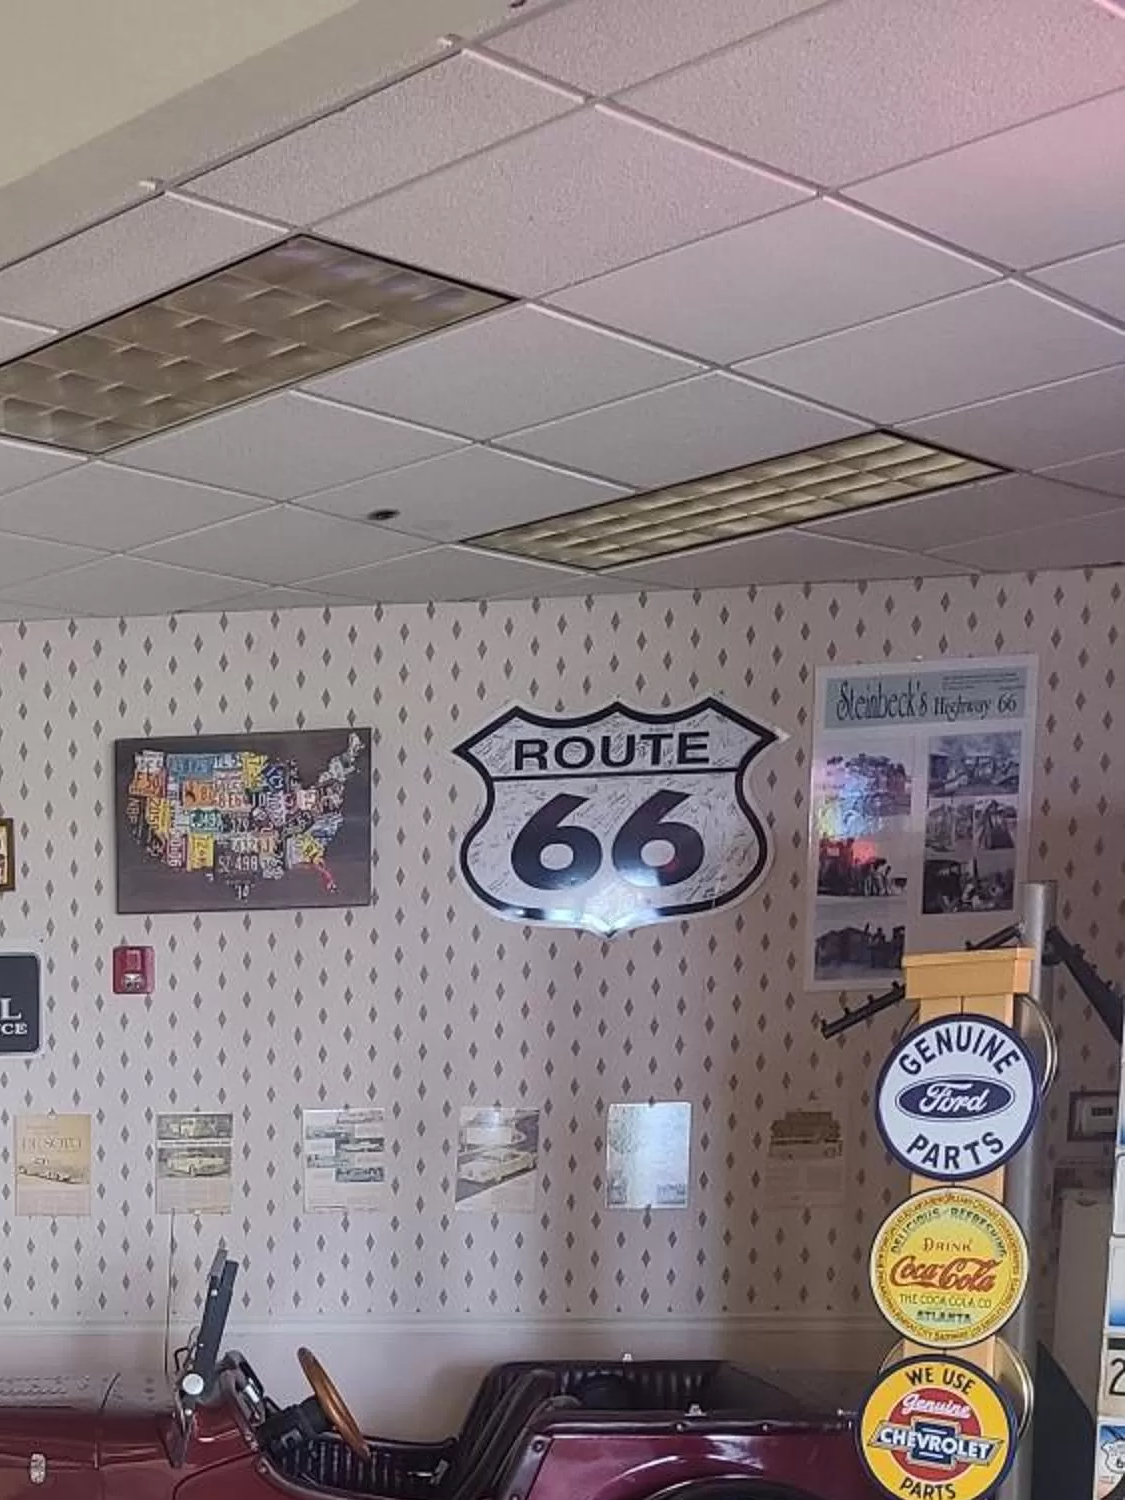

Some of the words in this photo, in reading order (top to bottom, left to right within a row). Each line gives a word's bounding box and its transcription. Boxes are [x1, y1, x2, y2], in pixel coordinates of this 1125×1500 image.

[997, 691, 1018, 713] 66
[514, 731, 710, 771] ROUTE
[510, 789, 705, 890] 66
[899, 1025, 1022, 1075] GENUINE
[918, 1080, 991, 1113] Ford
[906, 1130, 1005, 1170] PARTS
[923, 1237, 972, 1252] DRINK
[899, 1293, 918, 1305] THE
[905, 1367, 935, 1386] WE
[942, 1368, 976, 1395] USE
[901, 1393, 971, 1419] Genuine
[880, 1428, 990, 1459] CHEVROLET
[900, 1477, 957, 1500] PARTS
